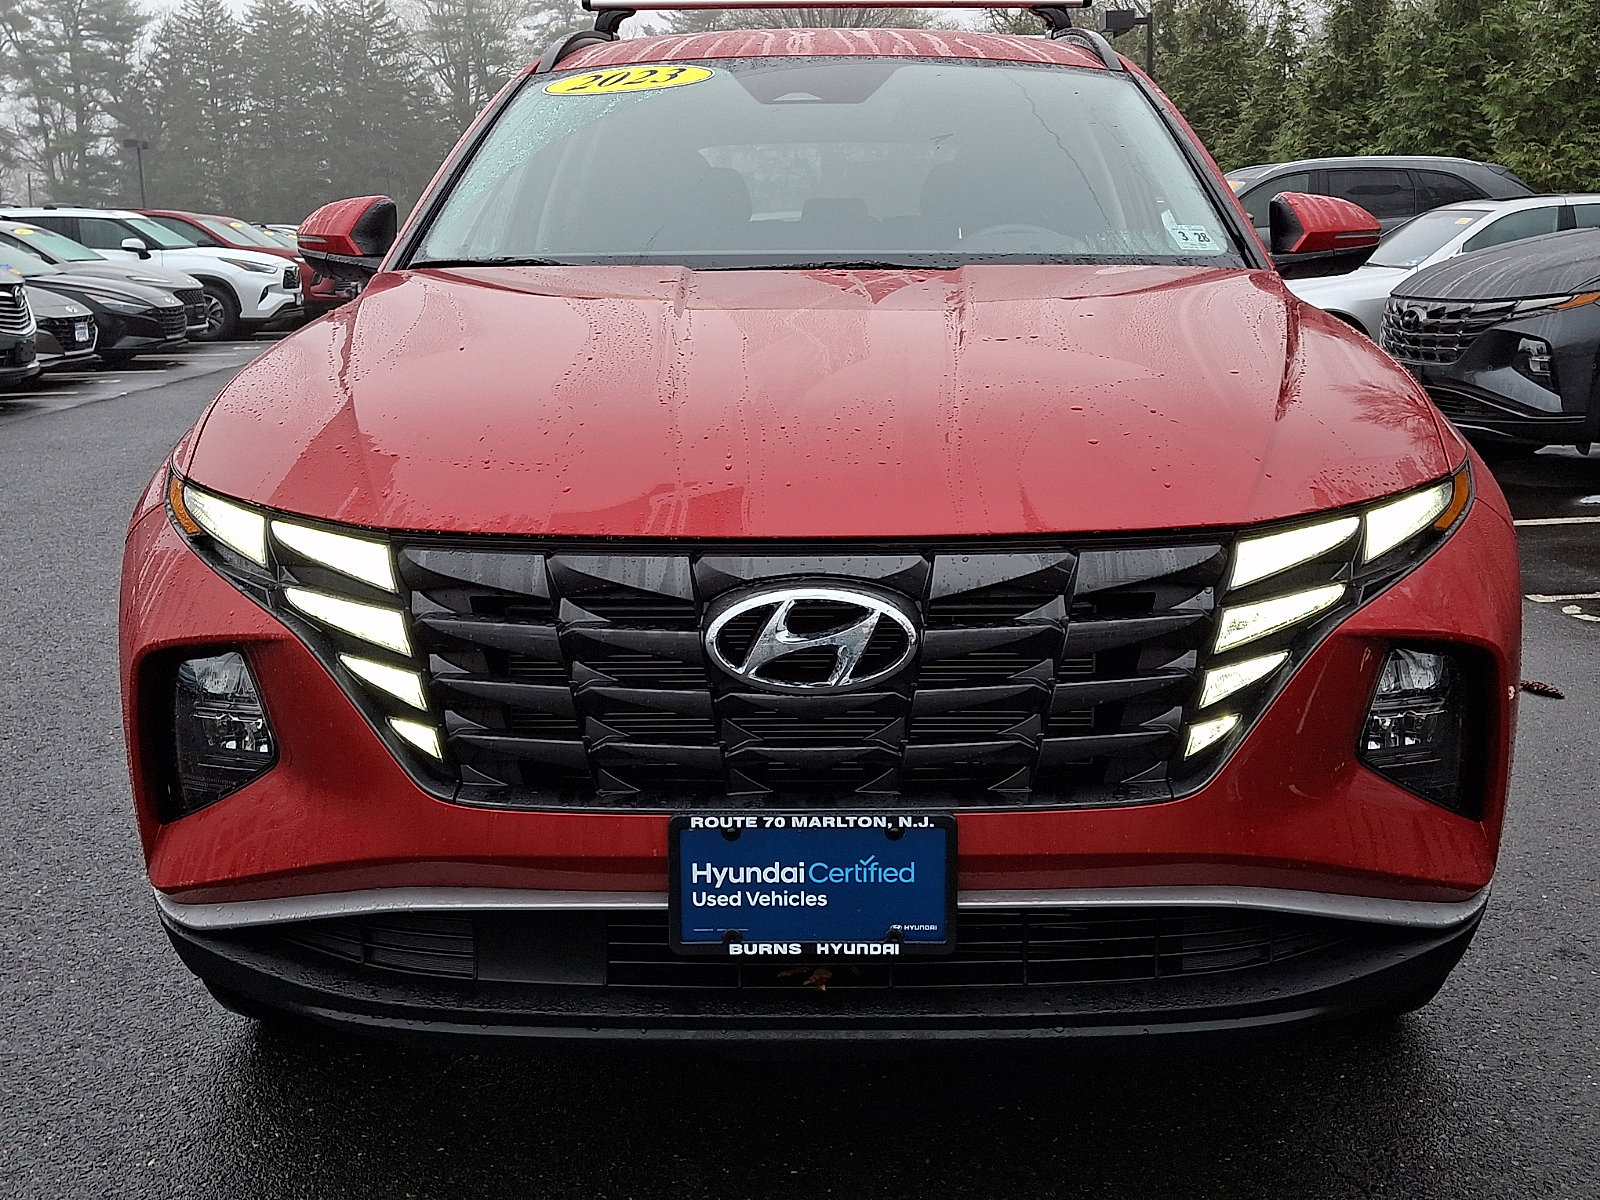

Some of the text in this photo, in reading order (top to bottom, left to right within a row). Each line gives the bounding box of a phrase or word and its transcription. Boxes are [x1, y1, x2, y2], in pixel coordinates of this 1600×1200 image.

[567, 68, 687, 91] 2023
[1178, 230, 1211, 243] 3 28
[690, 816, 935, 829] ROUTE 70 MARLTON, N.J.
[691, 855, 915, 888] Hyundai Certified
[692, 890, 828, 907] Used Vehicles
[729, 943, 900, 955] BURNS HYUNDAI
